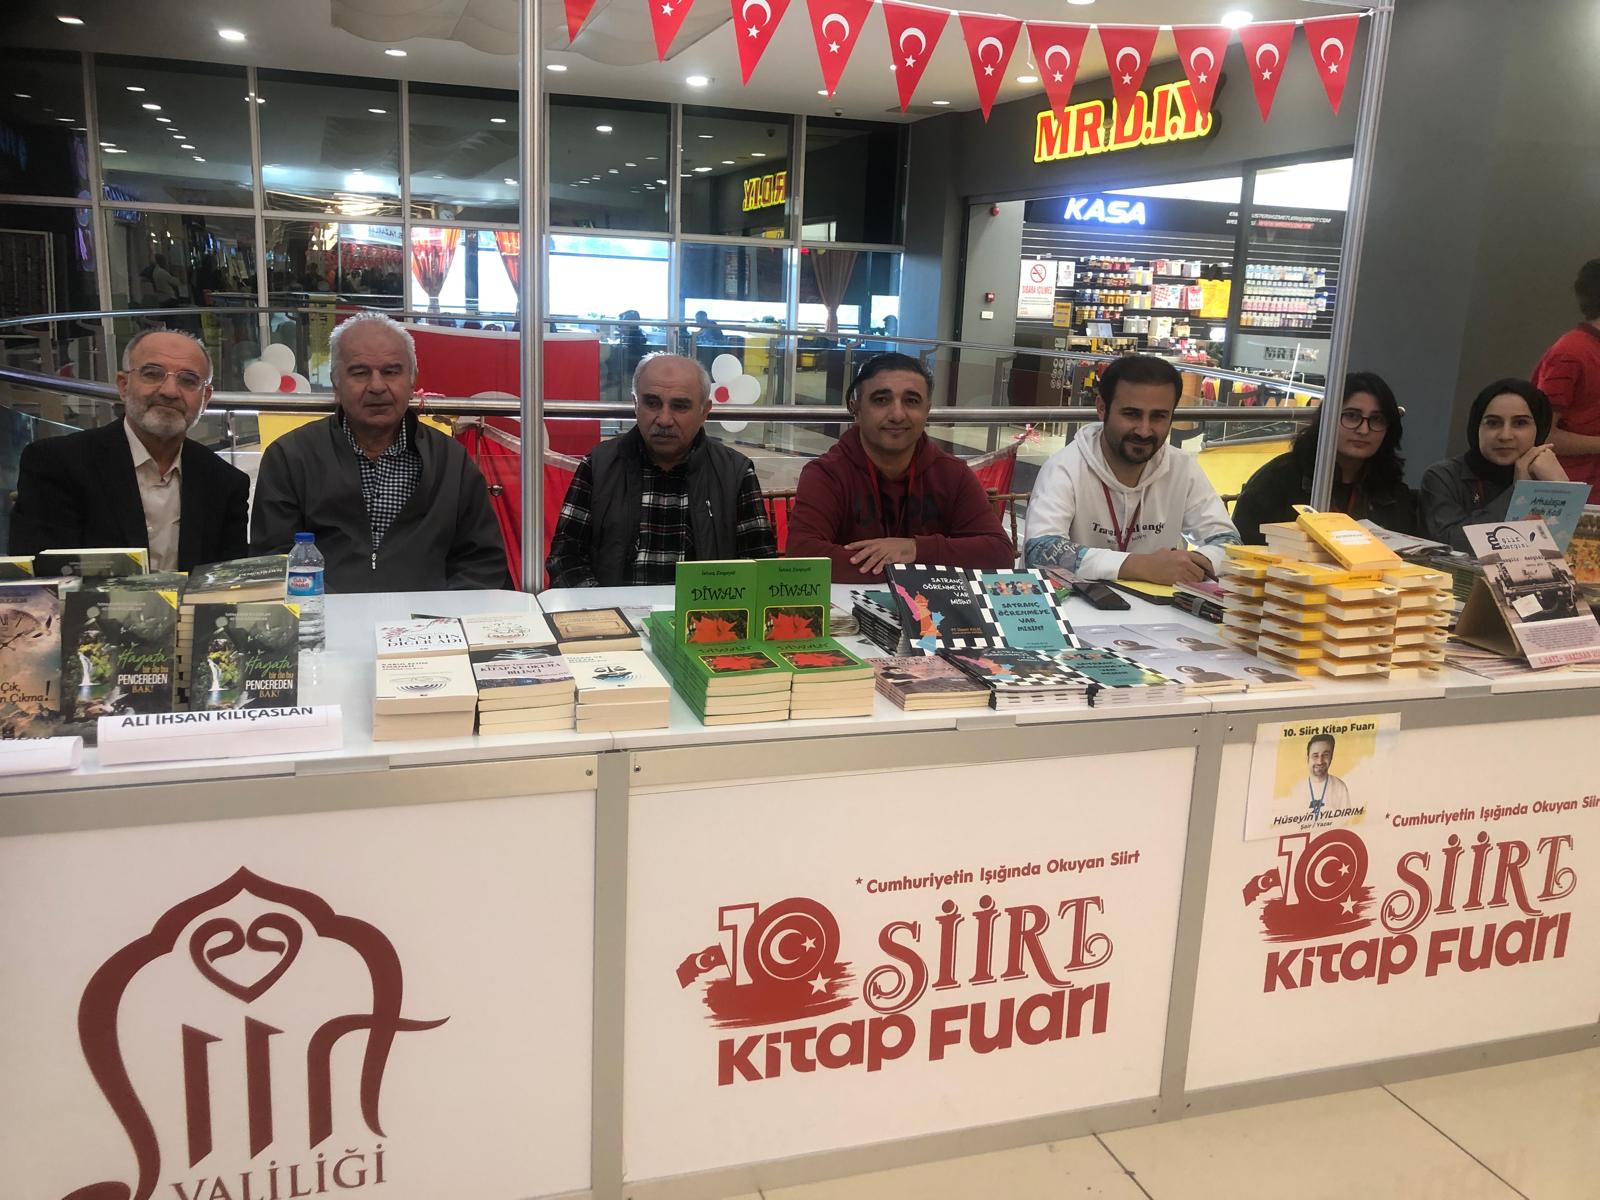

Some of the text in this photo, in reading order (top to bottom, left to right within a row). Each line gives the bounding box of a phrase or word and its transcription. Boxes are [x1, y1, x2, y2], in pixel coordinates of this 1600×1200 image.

[1063, 197, 1147, 225] KASA
[117, 673, 168, 684] PENCEREDEN
[245, 679, 293, 690] PENCEREDEN
[1283, 722, 1375, 737] 10. Siirt Kitap Fuarı
[1273, 806, 1365, 826] Hüseyin YILDIRIM
[1392, 794, 1600, 828] Cumhuriyetin Işığında Okuyan Siir
[1316, 820, 1333, 828] Yazar
[866, 849, 1141, 894] Cumhuriyetin Işığında Okuyan Siirt
[171, 1143, 388, 1200] VALİLİĞİ
